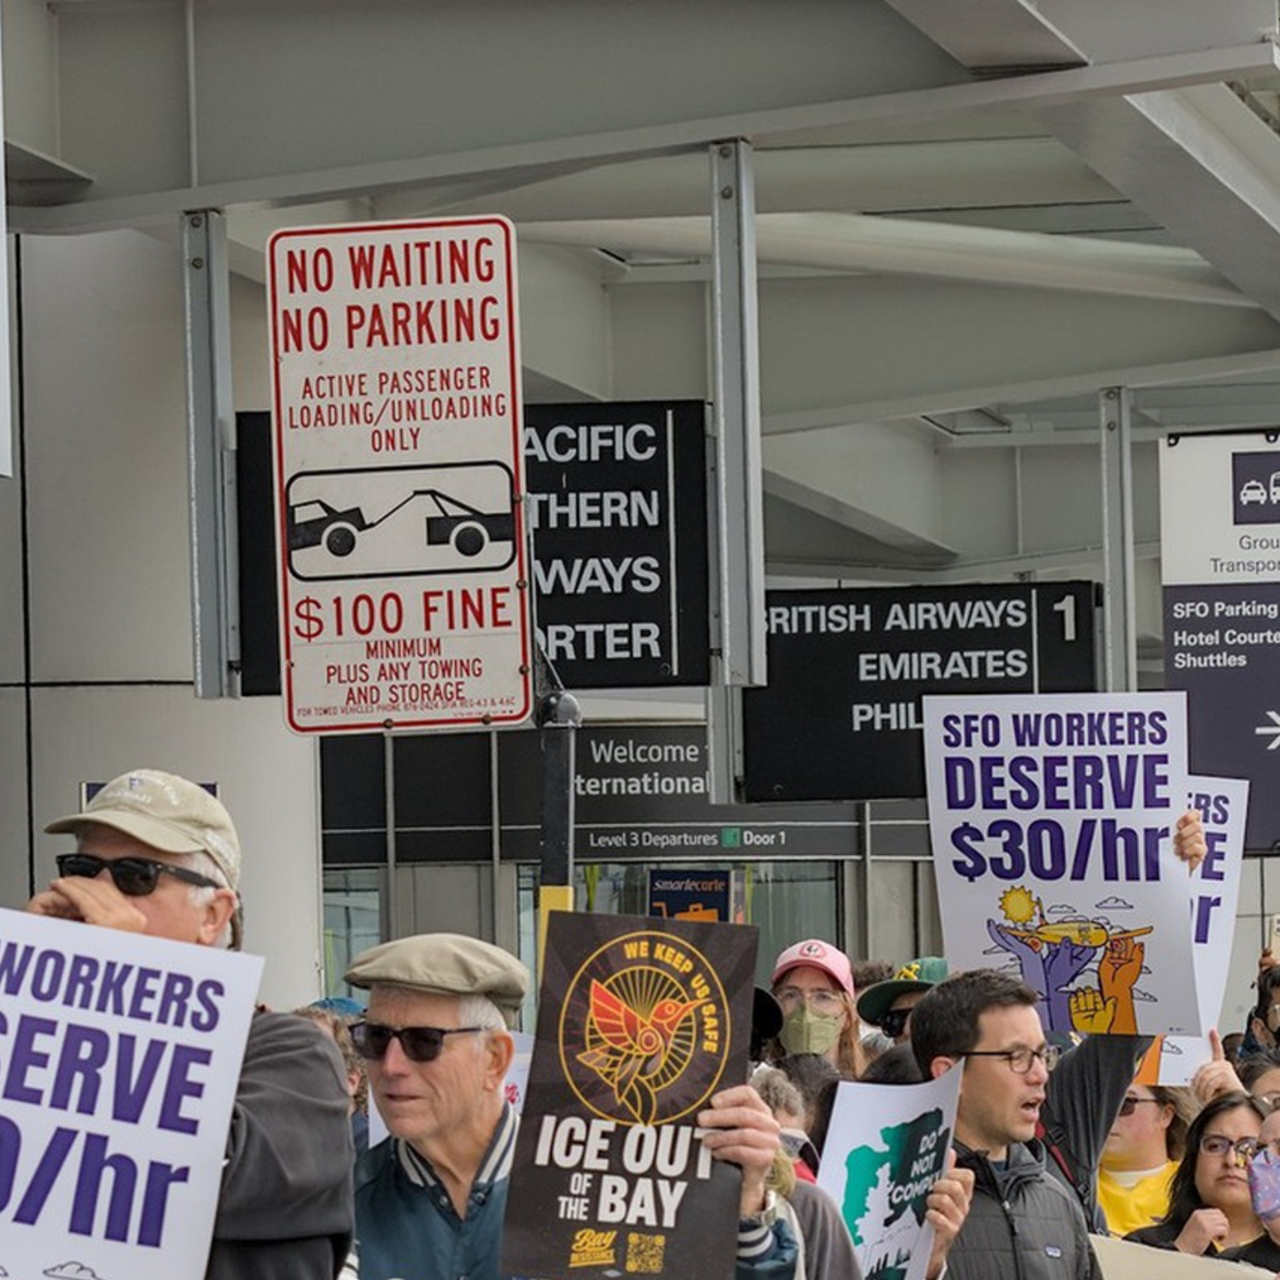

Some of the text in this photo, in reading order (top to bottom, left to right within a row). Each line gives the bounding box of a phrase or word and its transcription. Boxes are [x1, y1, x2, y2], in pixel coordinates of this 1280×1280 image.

[287, 237, 495, 294] NO WAITING
[282, 295, 500, 353] NO PARKING
[302, 366, 491, 400] ACTIVE PASSENGER
[288, 393, 507, 430] LOADING/UNLOADING
[371, 427, 420, 453] ONLY
[294, 587, 513, 643] $100 FINE
[884, 599, 1028, 630] AIRWAYS
[1053, 595, 1077, 641] 1
[1173, 601, 1210, 618] SFO
[1214, 600, 1279, 619] Parking
[366, 637, 442, 660] MINIMUM
[1174, 630, 1220, 647] Hotel
[326, 658, 483, 684] PLUS ANY TOWING
[858, 649, 1028, 681] EMIRATES
[1174, 651, 1247, 668] Shuttles
[345, 681, 466, 706] AND STORAGE
[942, 711, 1167, 749] SFO WORKERS
[590, 739, 699, 763] Welcome
[943, 754, 1171, 811] DESERVE
[589, 830, 786, 849] Level 3 Departures Door 1
[950, 818, 1170, 883] $30/hr
[624, 941, 719, 1054] WE KEEP US SAFE
[535, 1114, 715, 1180] ICE OUT
[918, 1131, 937, 1154] DO
[910, 1151, 937, 1178] NOT
[569, 1172, 593, 1196] OF
[557, 1196, 590, 1221] THE
[597, 1175, 689, 1229] BAY
[571, 1227, 618, 1252] Bay
